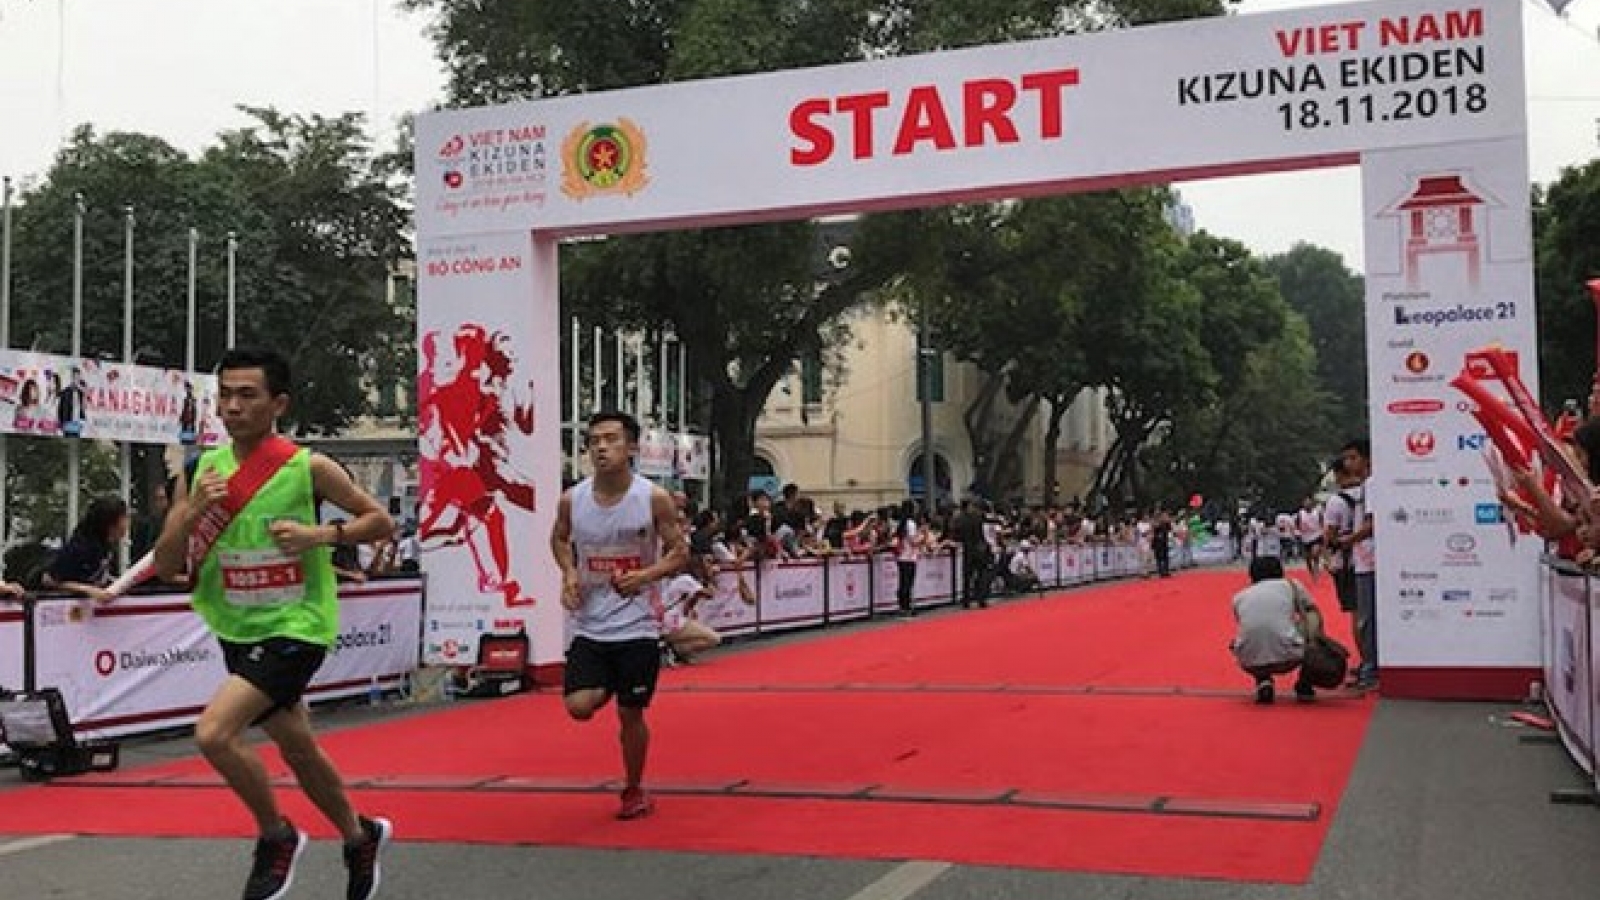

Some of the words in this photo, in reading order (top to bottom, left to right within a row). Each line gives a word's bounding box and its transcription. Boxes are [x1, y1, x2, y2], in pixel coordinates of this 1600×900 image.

[1275, 21, 1366, 57] VIET
[1379, 9, 1483, 47] NAM
[1177, 63, 1326, 106] KIZUNA
[1340, 45, 1485, 87] EKIDEN
[789, 68, 1080, 166] START
[1278, 83, 1487, 131] 18.11.2018
[470, 128, 503, 147] VIET
[508, 126, 546, 141] NAM
[470, 143, 544, 161] KIZUNA
[470, 158, 544, 175] EKIDEN
[500, 257, 521, 269] AN
[1394, 304, 1494, 327] Leopalace
[1495, 301, 1516, 319] 21
[86, 387, 178, 417] KANAGAWA
[285, 567, 297, 583] 1
[333, 626, 376, 654] palace
[378, 623, 392, 644] 21
